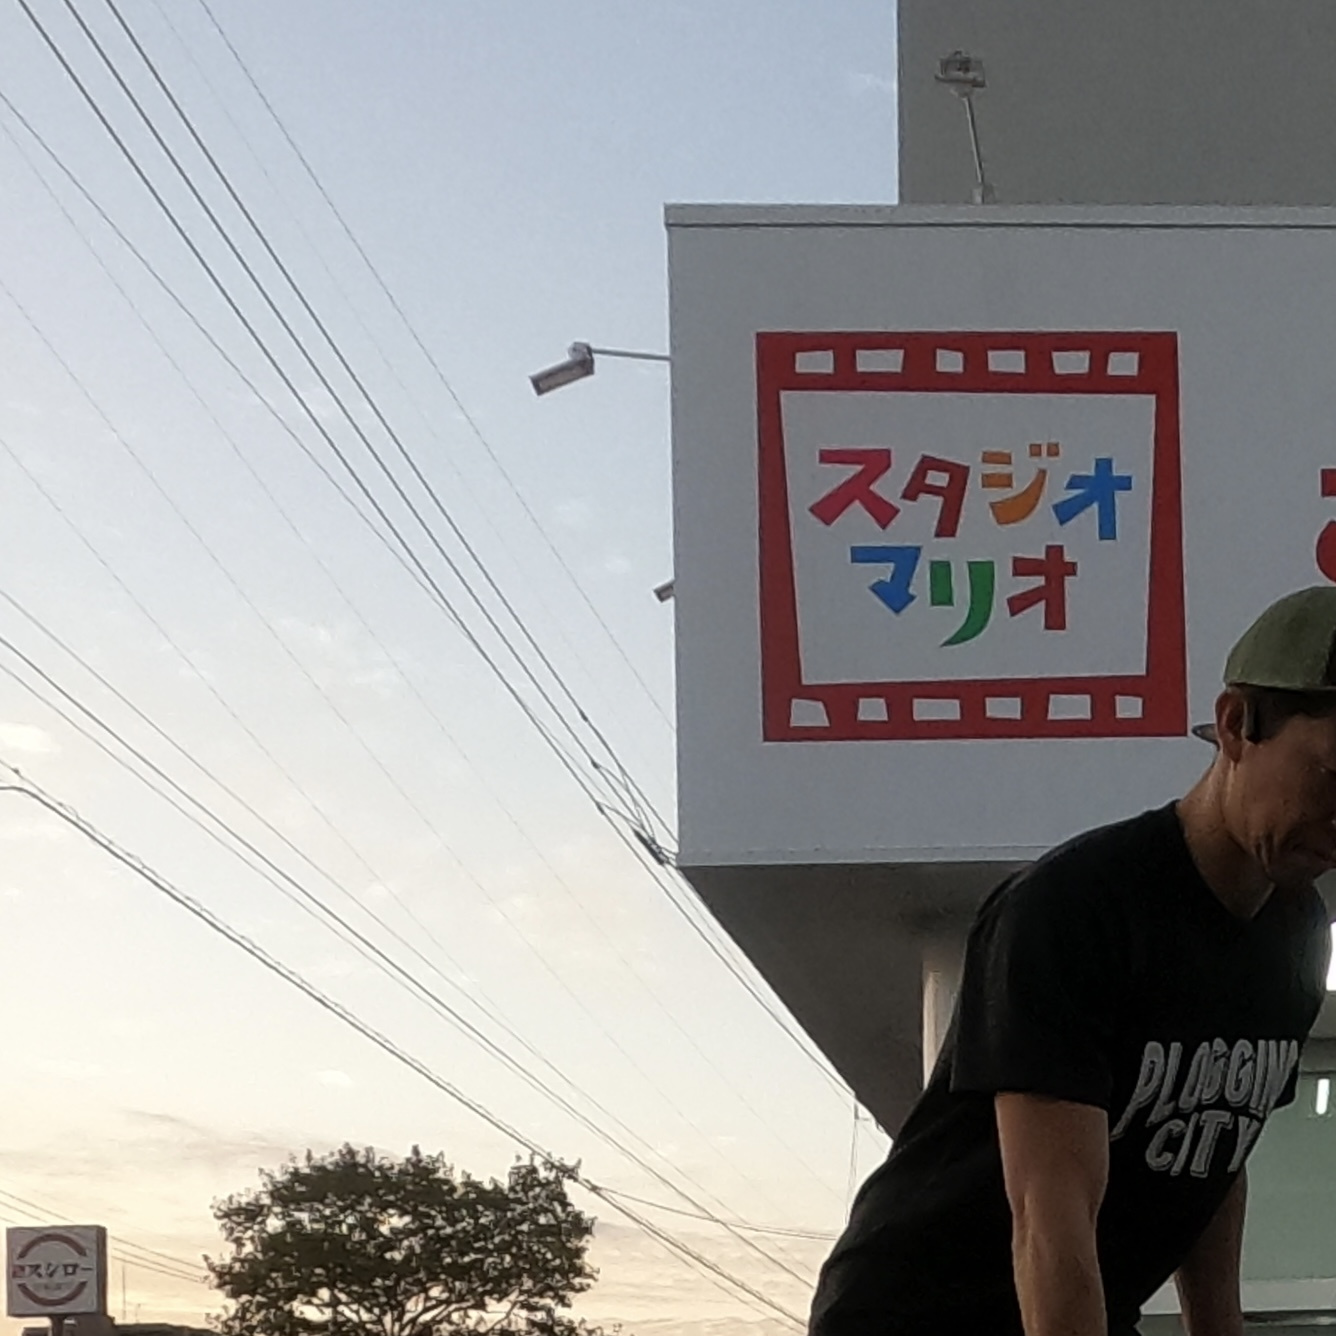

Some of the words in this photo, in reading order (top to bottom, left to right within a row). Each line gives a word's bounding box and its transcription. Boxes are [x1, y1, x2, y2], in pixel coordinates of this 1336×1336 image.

[808, 441, 1133, 540] スタジオ
[849, 544, 1078, 648] マリオ
[1145, 1109, 1261, 1178] CITY
